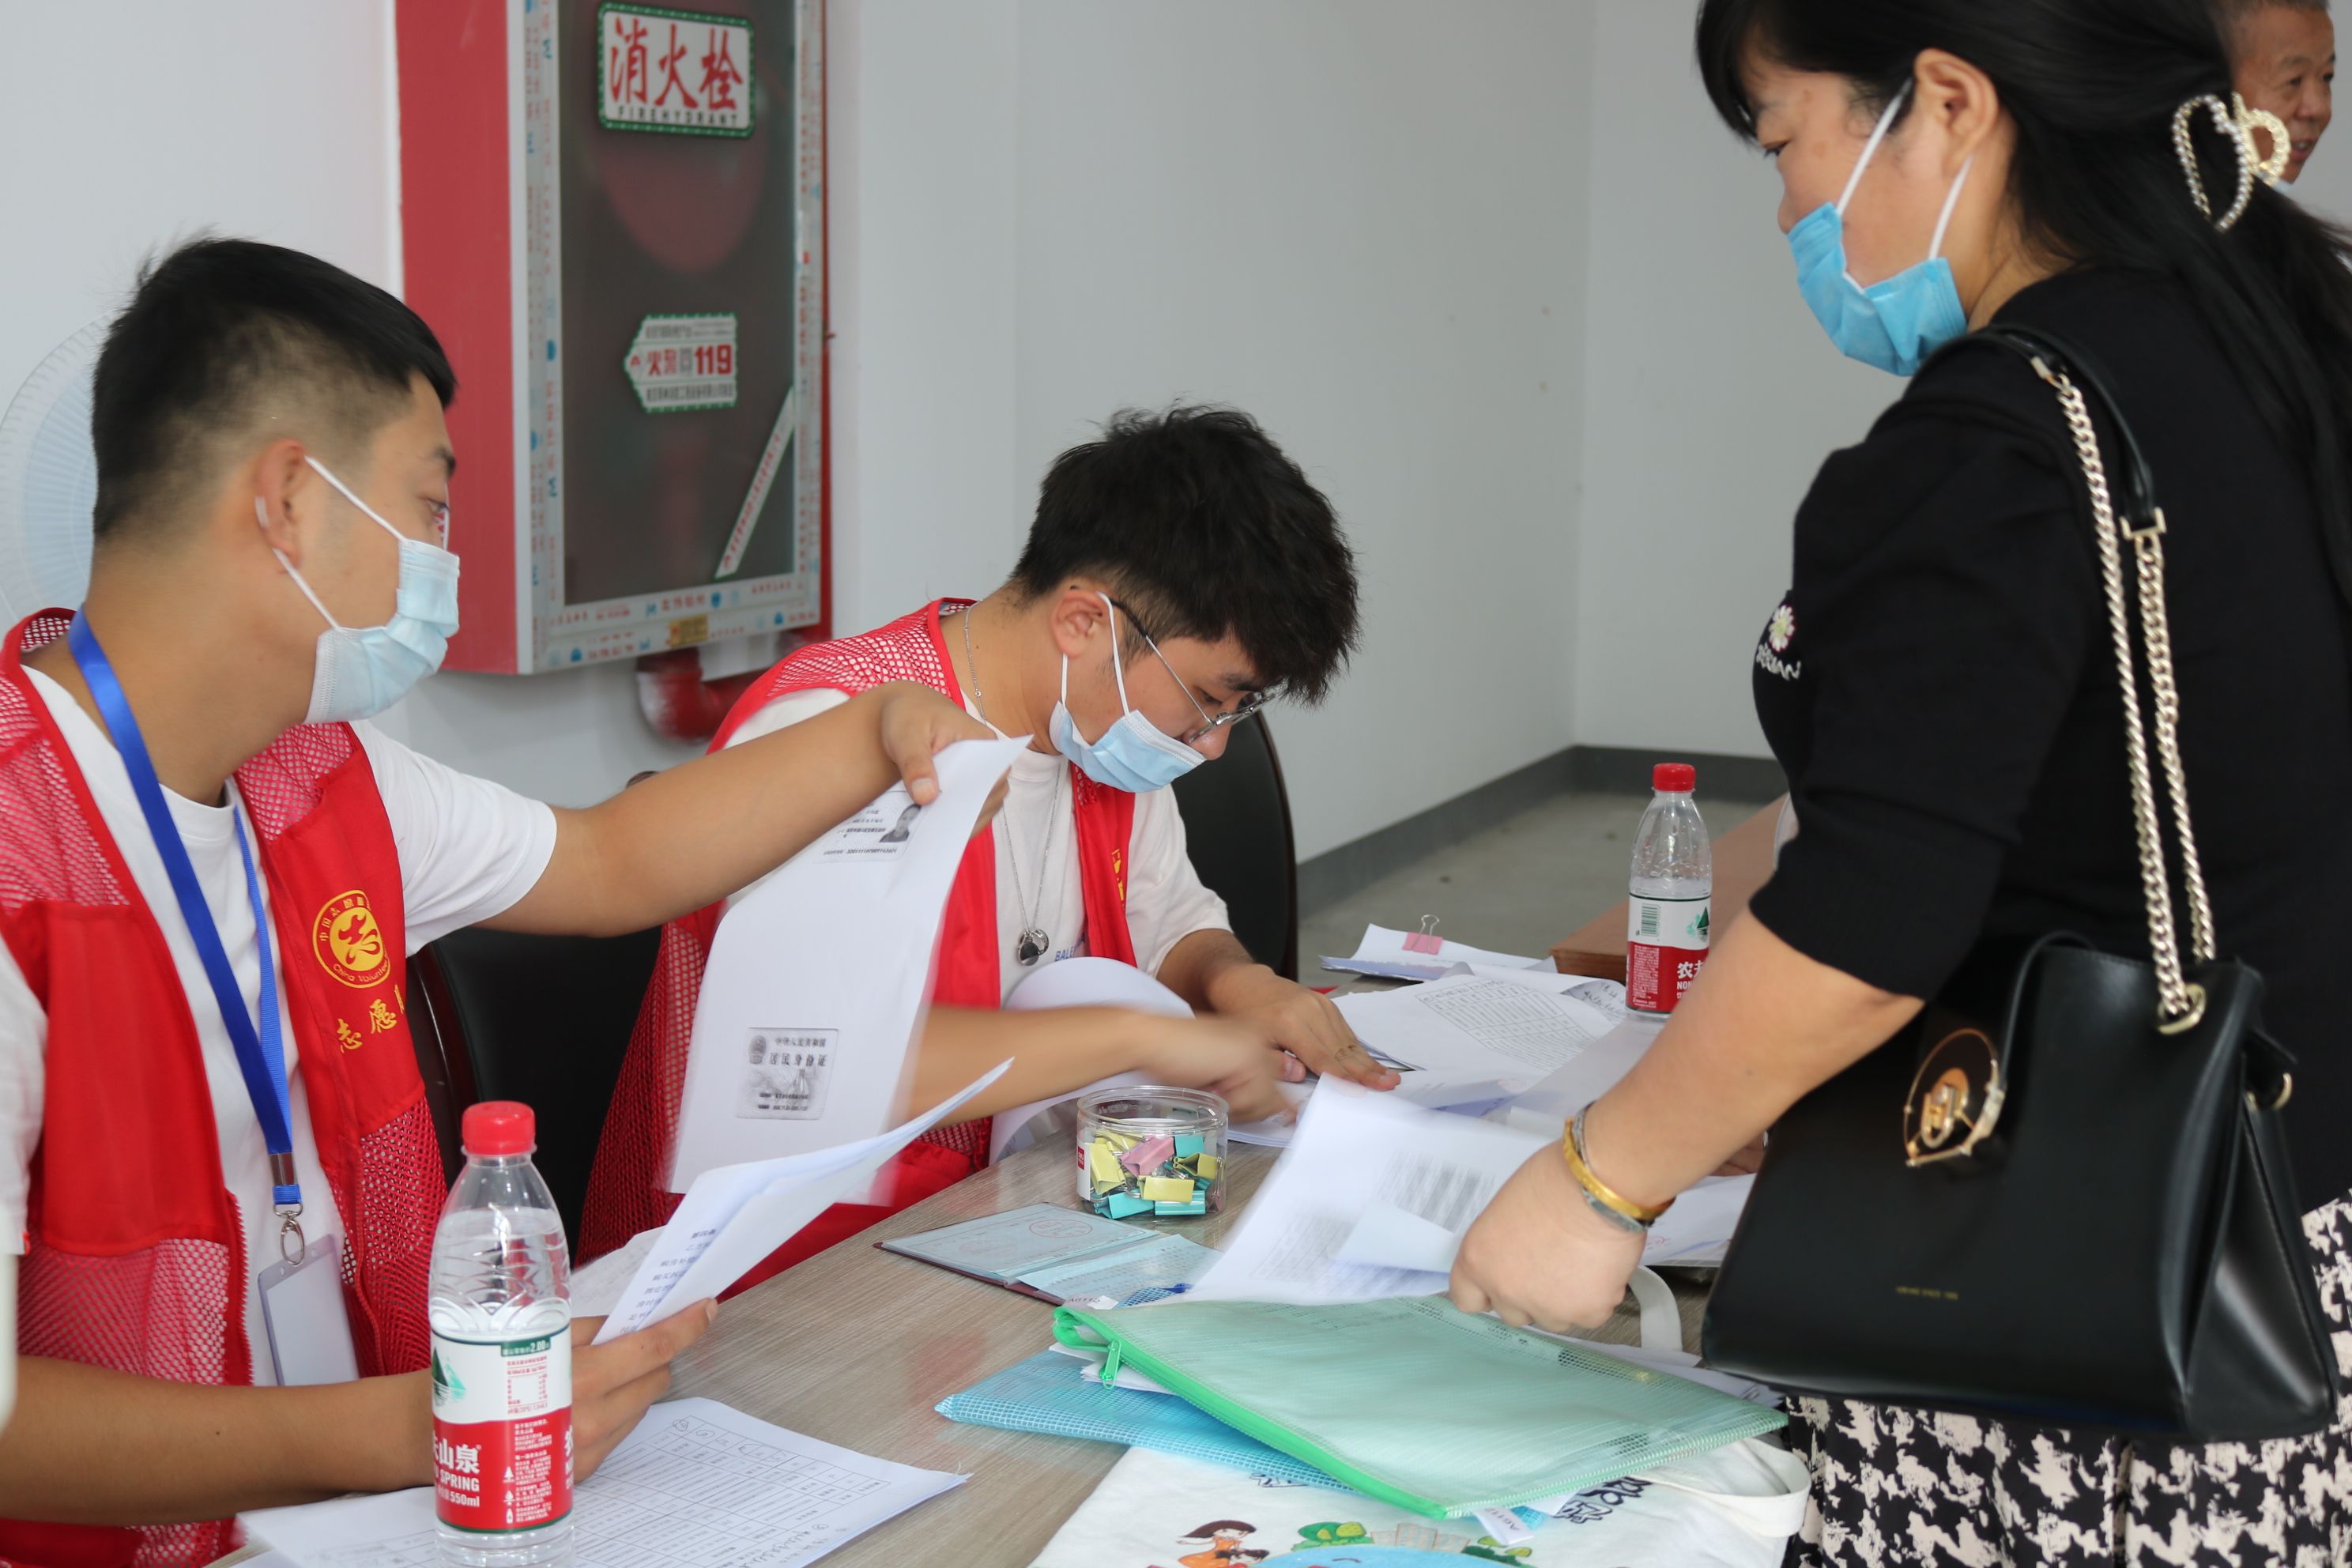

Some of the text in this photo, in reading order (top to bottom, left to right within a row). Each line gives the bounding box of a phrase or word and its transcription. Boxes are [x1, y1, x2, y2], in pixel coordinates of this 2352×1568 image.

[610, 16, 743, 111] 消火栓
[695, 343, 732, 375] 119
[337, 984, 405, 1054] 志愿
[439, 1469, 481, 1492] SPRING
